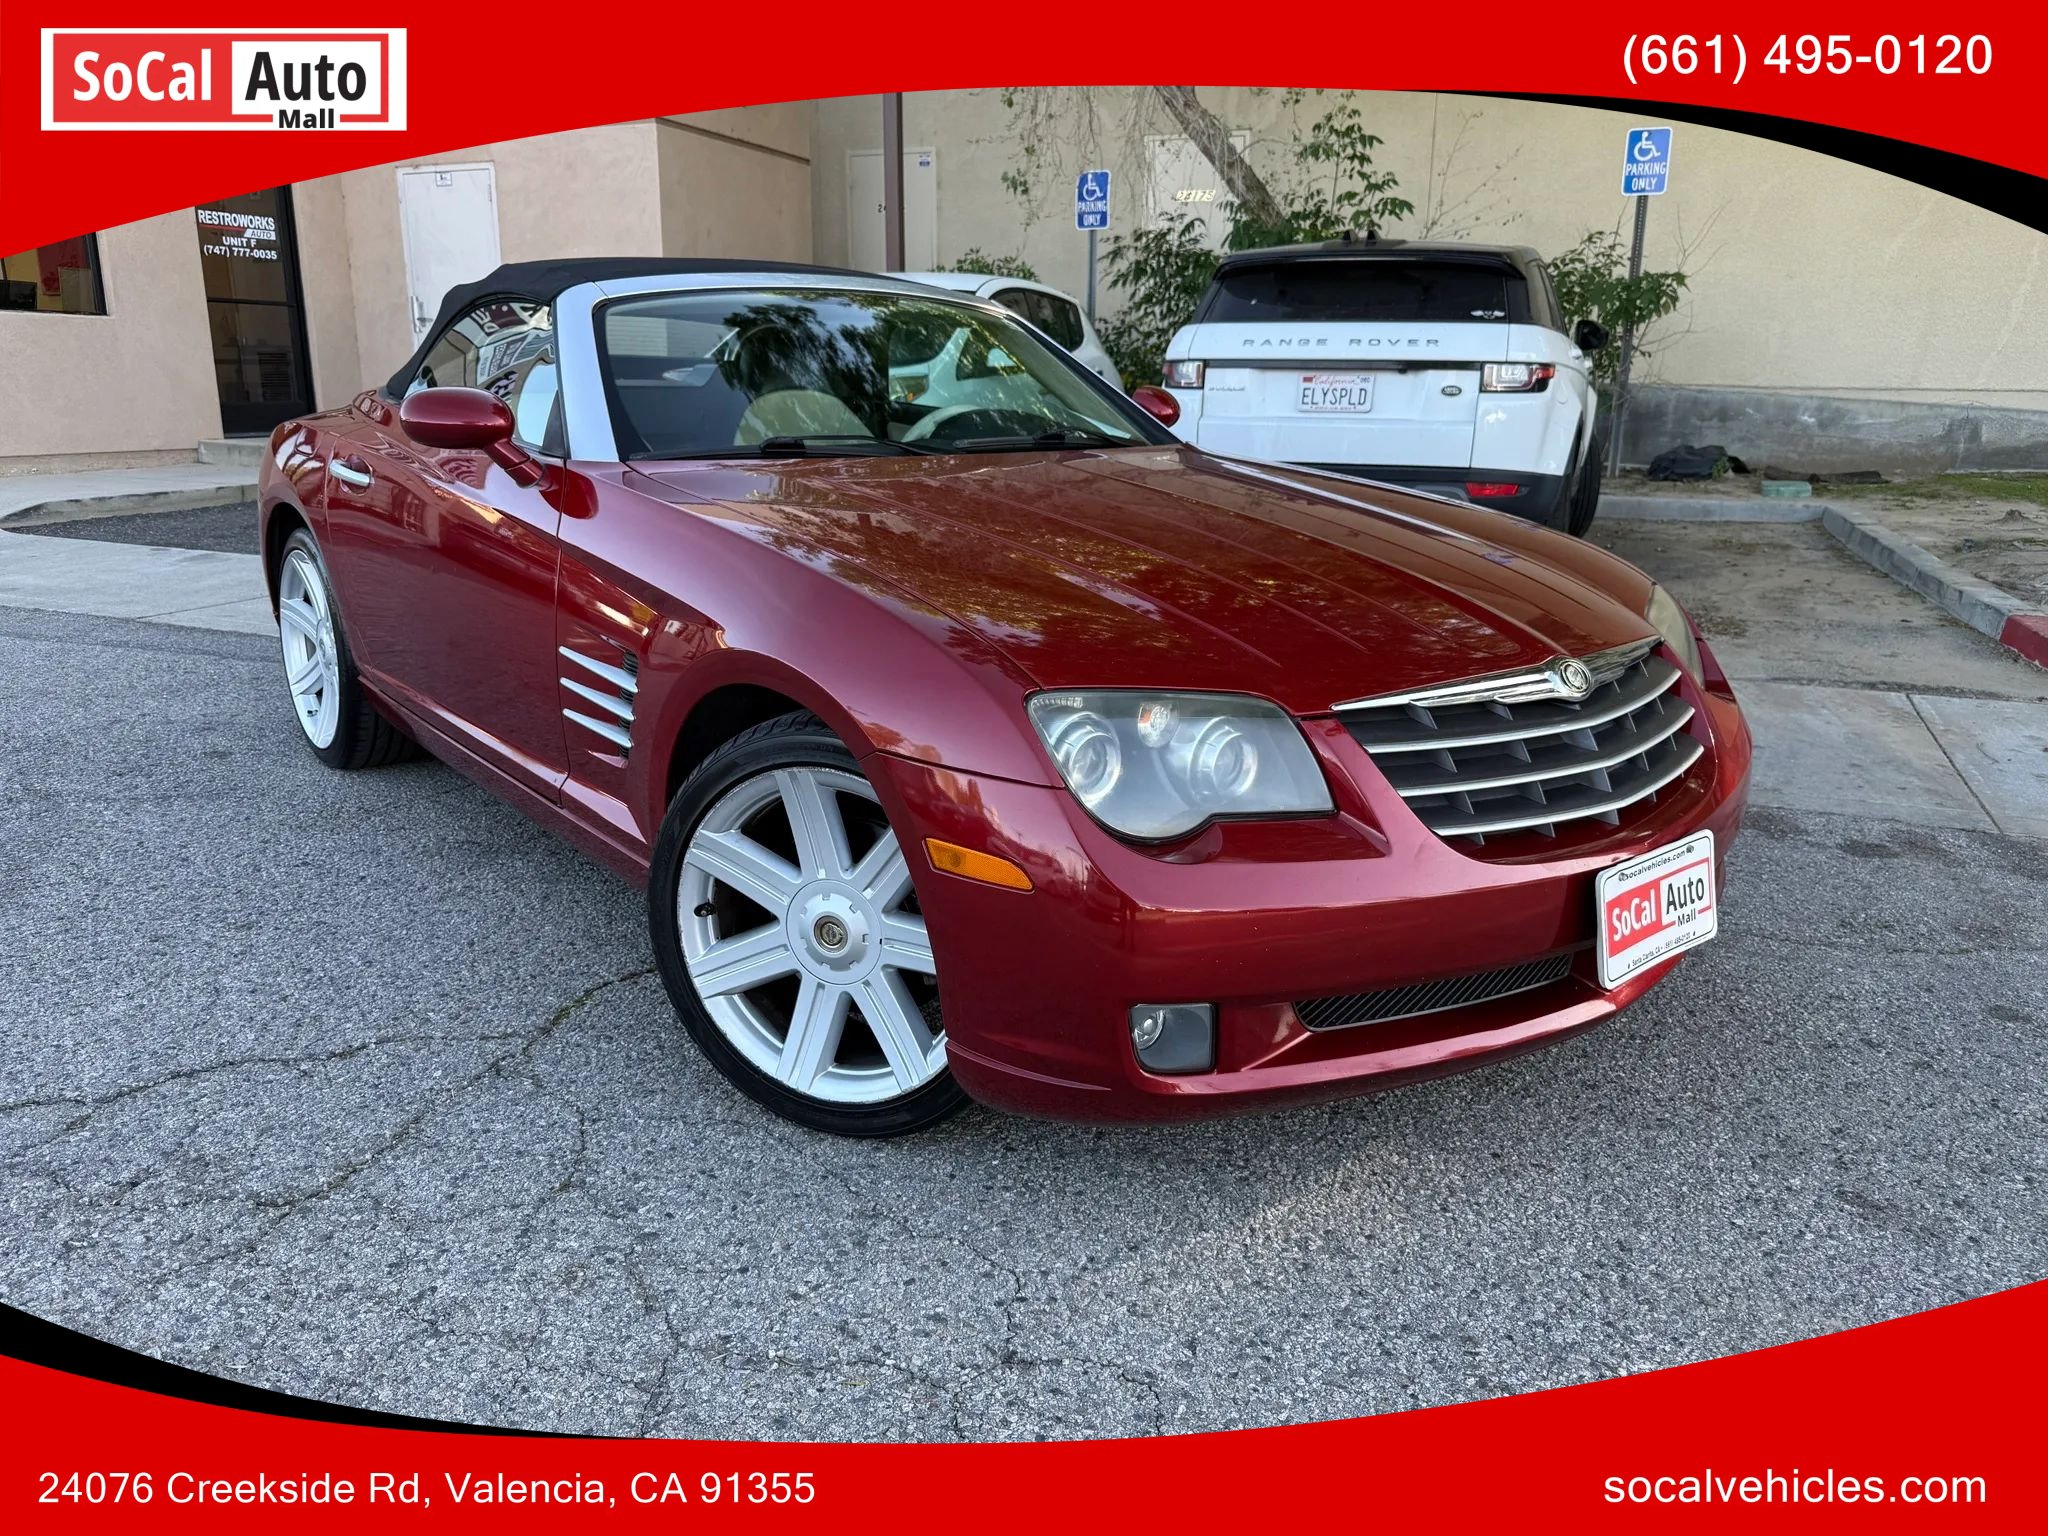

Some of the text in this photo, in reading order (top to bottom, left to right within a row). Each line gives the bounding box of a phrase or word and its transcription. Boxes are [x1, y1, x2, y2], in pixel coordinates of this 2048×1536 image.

[1625, 161, 1667, 176] PARKING
[1631, 176, 1658, 191] ONLY
[197, 209, 275, 230] RESTROWORKS
[222, 236, 257, 247] UNIT F
[250, 230, 272, 239] AUTO
[203, 245, 278, 260] (747) 777-0035
[1242, 338, 1440, 347] RANGE ROVER
[1301, 387, 1368, 406] ELYSPLD
[1612, 877, 1705, 942] SoCal Auto
[1677, 909, 1697, 928] Mall
